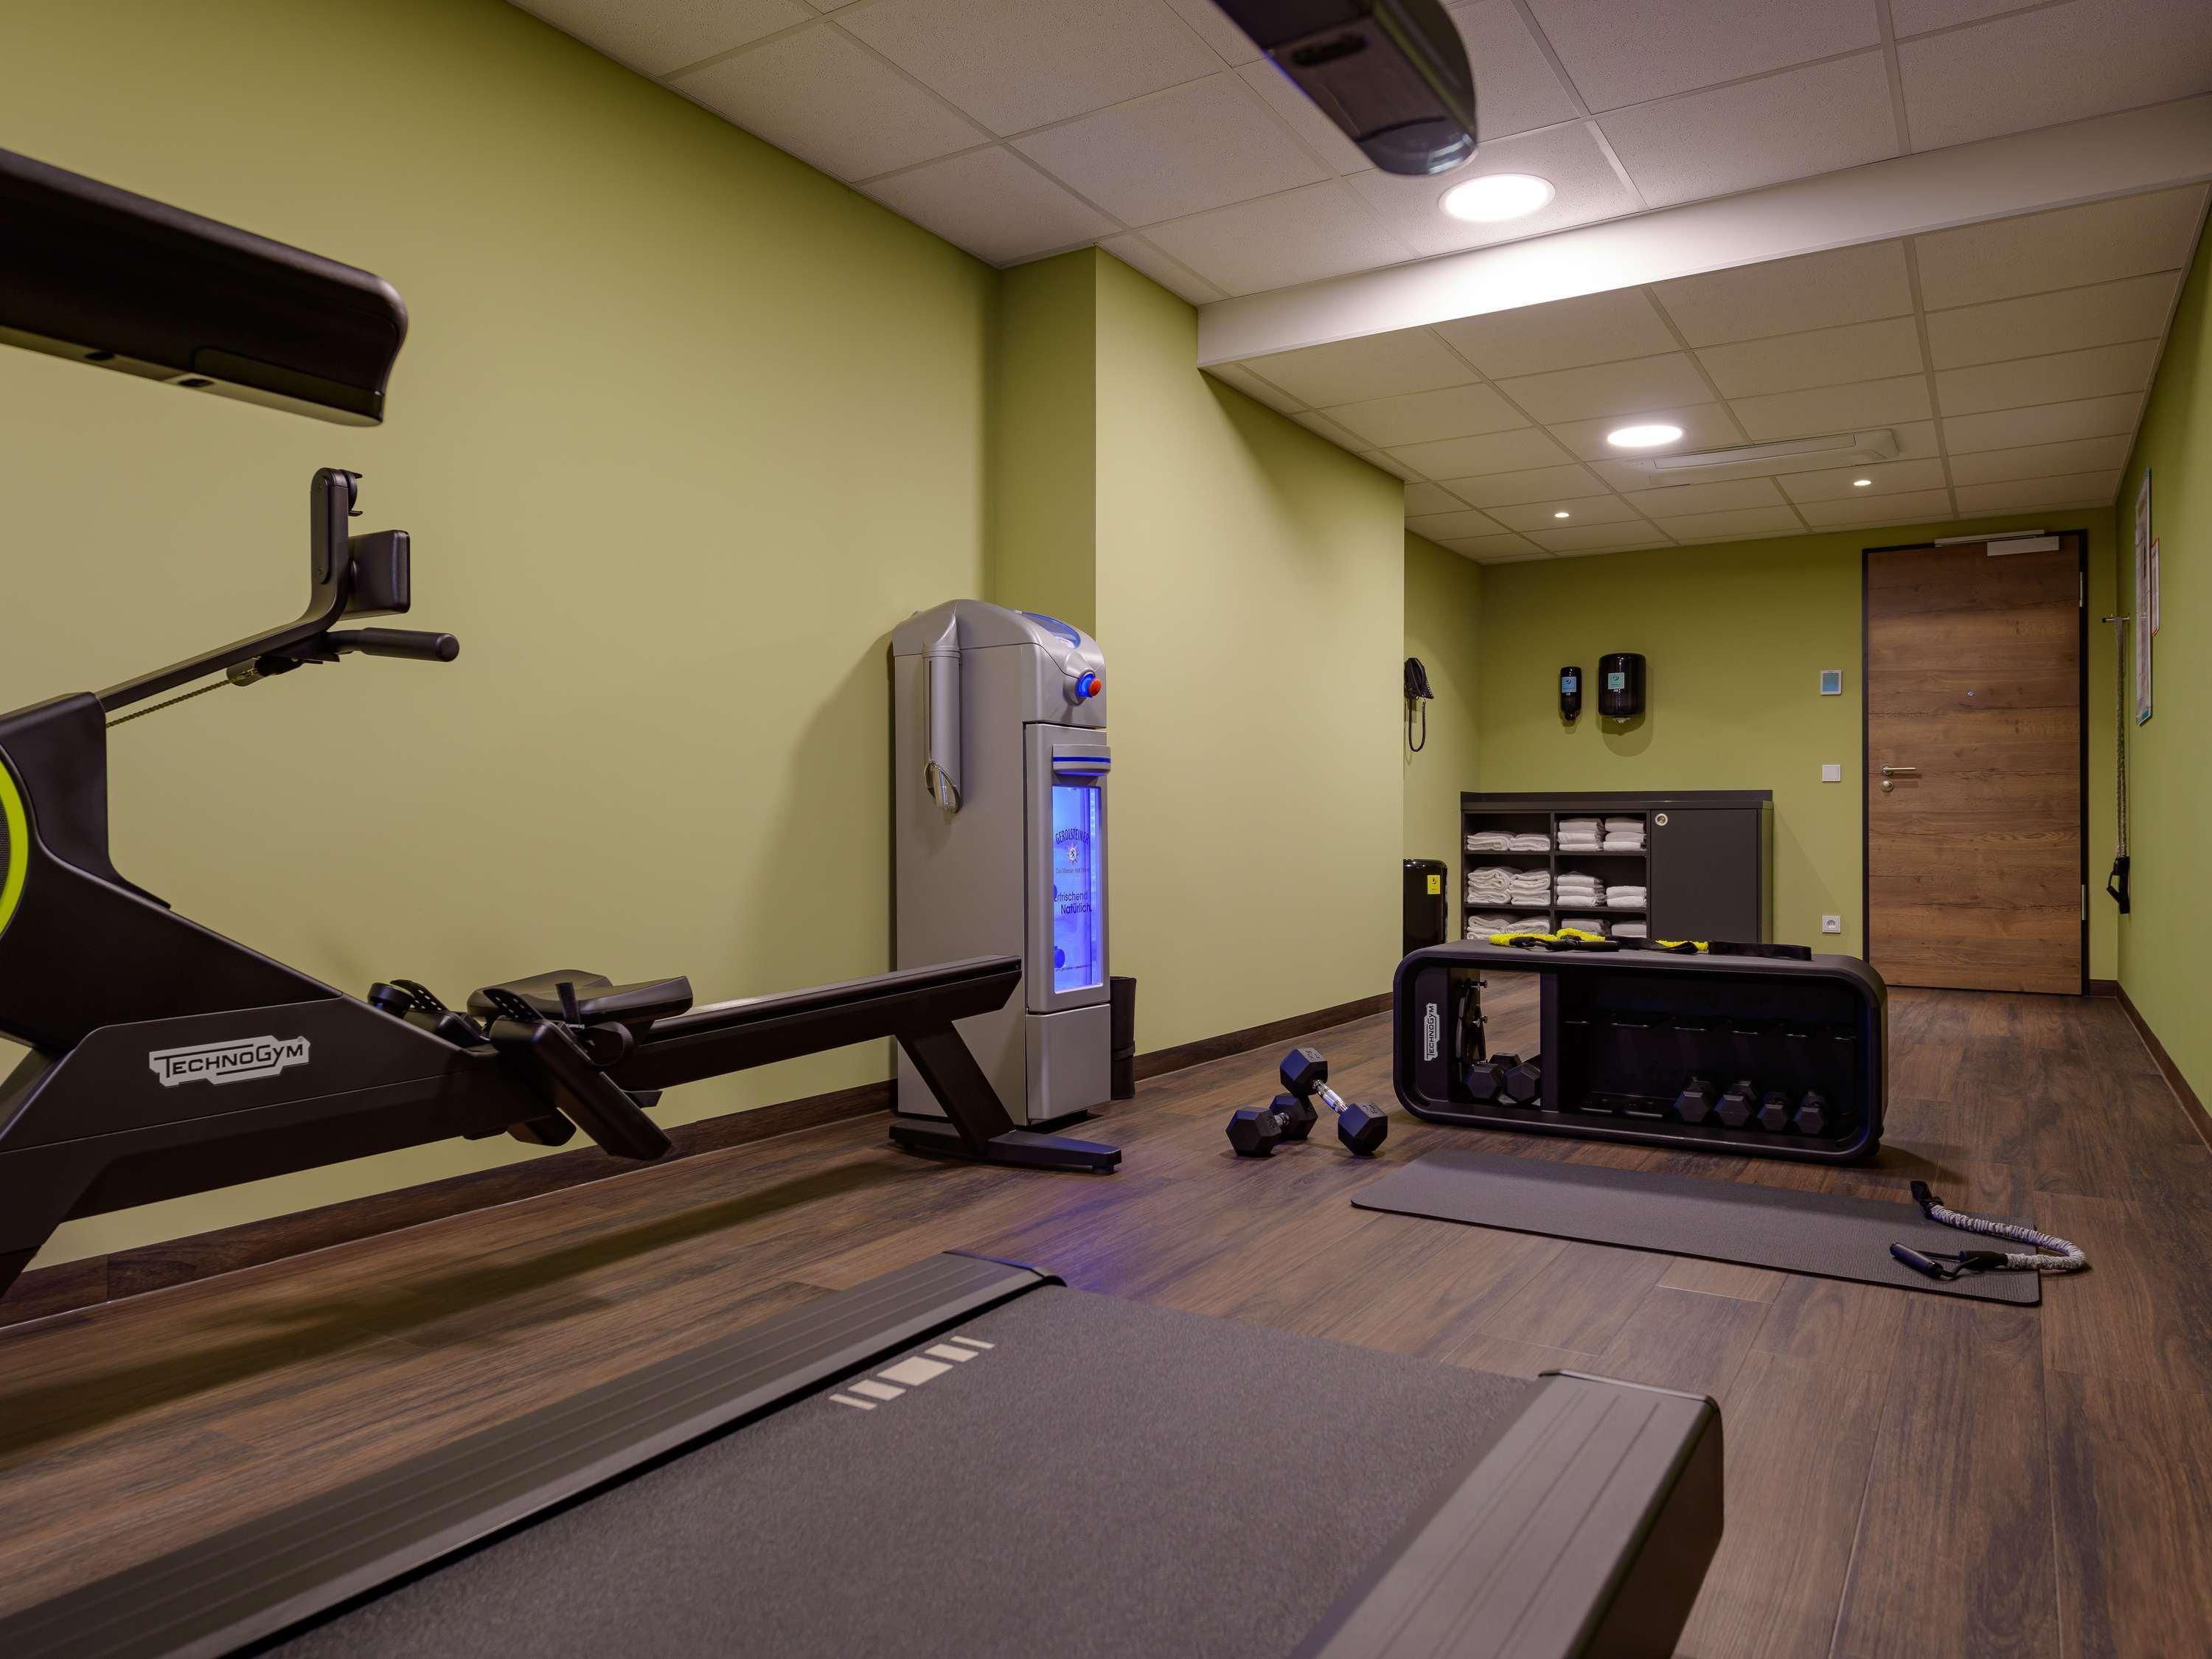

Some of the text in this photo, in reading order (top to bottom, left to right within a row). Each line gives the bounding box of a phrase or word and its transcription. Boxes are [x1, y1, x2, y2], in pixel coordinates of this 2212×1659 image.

[1055, 828, 1090, 844] GEROLSTEINER
[1426, 1004, 1437, 1060] TECHNOGYM
[153, 1041, 305, 1079] TECHNOGYM
